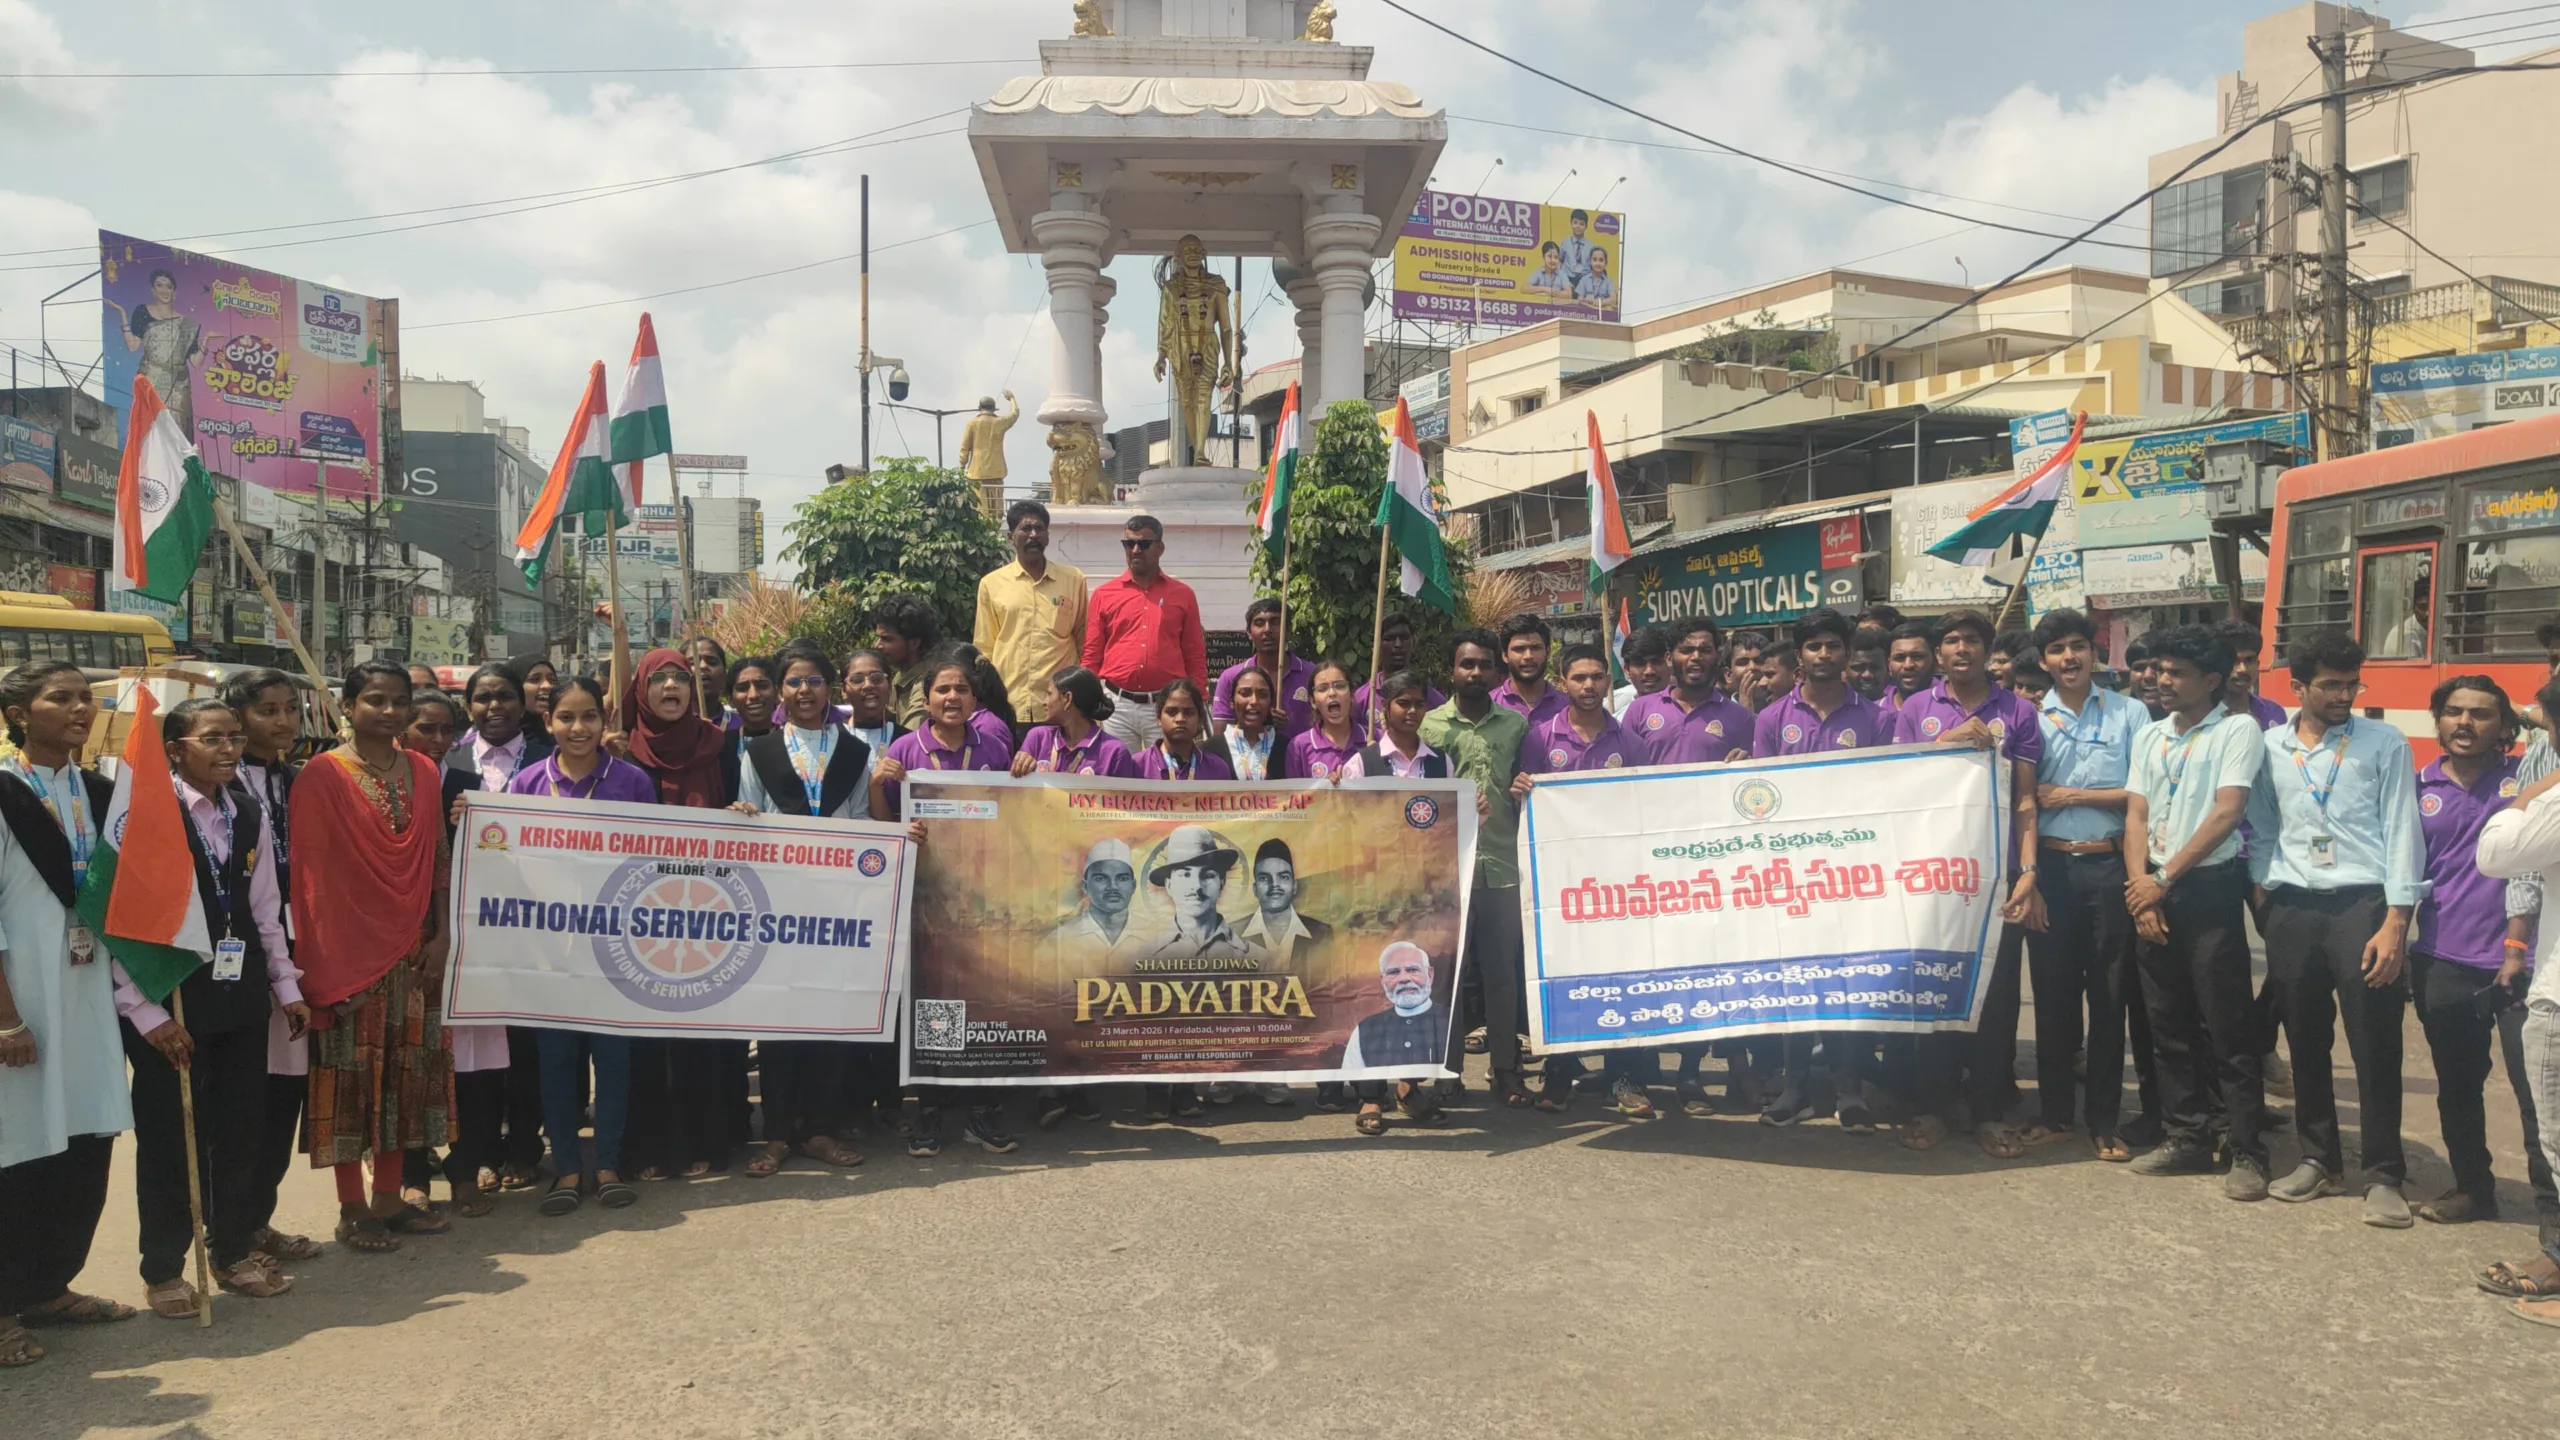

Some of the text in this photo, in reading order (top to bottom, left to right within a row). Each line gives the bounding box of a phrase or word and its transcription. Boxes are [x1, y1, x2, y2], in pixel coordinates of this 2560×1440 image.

[1432, 193, 1532, 228] PODAR
[1432, 217, 1534, 238] INTERNATIONAL SCHOOL
[1409, 245, 1526, 267] ADMISSIONS OPEN
[1435, 261, 1464, 273] Nursery
[1474, 265, 1495, 274] Grade
[1432, 273, 1468, 283] DONATIONS
[1485, 278, 1514, 287] DEPOSITS
[1430, 296, 1471, 312] 95132
[1534, 307, 1598, 321] podareducation.org
[2408, 365, 2465, 382] రకముల
[2497, 390, 2540, 407] boAt
[1917, 505, 1938, 521] Gift
[2031, 551, 2079, 568] LEO
[2028, 564, 2081, 583] Print Packs
[1647, 570, 1821, 623] SURYA OPTICALS
[1826, 594, 1858, 605] OAKLEY
[1069, 793, 1098, 808] MY
[1102, 795, 1178, 811] BHARAT
[1195, 794, 1279, 812] NELLORE
[519, 826, 855, 869] KRISHNA CHAITANYA DEGREE COLLEGE
[1652, 828, 1876, 858] ఆంధ్రప్రదేశ్ ప్రభుత్వము
[657, 862, 706, 877] NELLORE
[715, 866, 731, 878] AP
[1561, 857, 1980, 921] యువజన సర్వీసుల శాఖ
[478, 897, 873, 948] NATIONAL SERVICE SCHEME
[1135, 958, 1259, 971] SHAHEED DIWAS
[651, 980, 712, 998] SERVICE
[1568, 985, 1622, 1002] జిల్లా
[1627, 972, 1737, 995] యువజన
[1073, 976, 1316, 1023] PADYATRA
[1597, 1008, 1626, 1027] శ్రీ
[1630, 1002, 1684, 1024] పొట్టి
[1689, 993, 1819, 1018] శ్రీరాములు
[966, 1021, 1008, 1029] JOIN THE
[1101, 1027, 1111, 1035] 23
[1113, 1026, 1139, 1035] March
[1141, 1026, 1163, 1034] 2026
[1169, 1024, 1214, 1035] Faridabad,
[1216, 1024, 1250, 1034] Haryana
[1257, 1024, 1292, 1032] 10:00AM
[966, 1030, 1047, 1042] PADYATRA
[1145, 1039, 1177, 1047] FURTHER
[1178, 1038, 1222, 1046] STRENGTHEN
[1224, 1037, 1237, 1045] THE
[1239, 1037, 1260, 1045] SPIRIT
[1271, 1036, 1310, 1044] PATRIOTISM
[1197, 1052, 1253, 1060] RESPONSIBILITY
